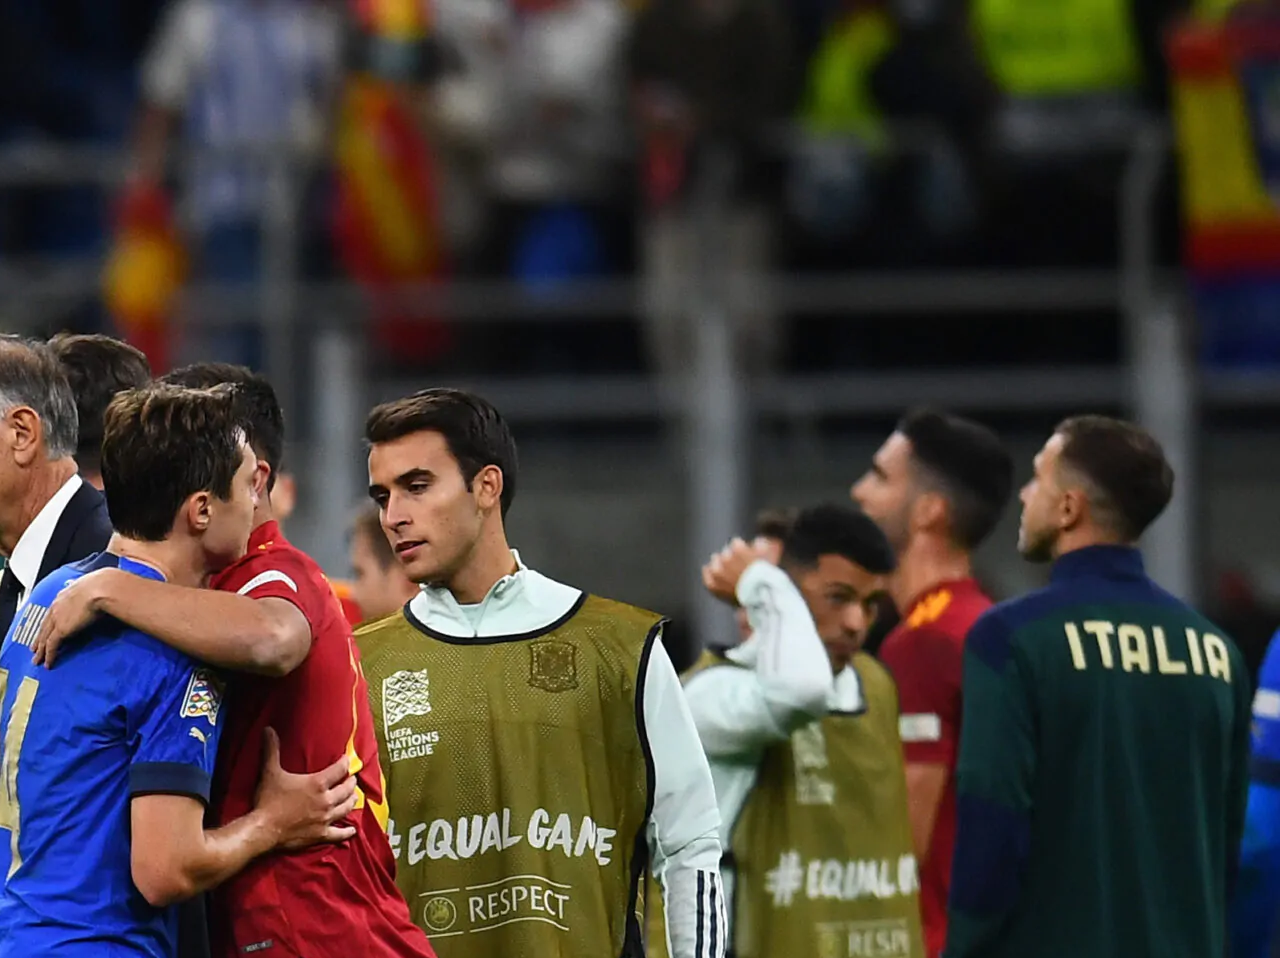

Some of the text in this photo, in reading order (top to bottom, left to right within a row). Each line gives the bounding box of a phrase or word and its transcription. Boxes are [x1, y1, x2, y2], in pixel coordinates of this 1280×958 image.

[1064, 620, 1231, 684] ITALIA
[387, 731, 440, 750] NATIONS
[389, 727, 413, 740] UEFA
[469, 885, 570, 923] RESPECT
